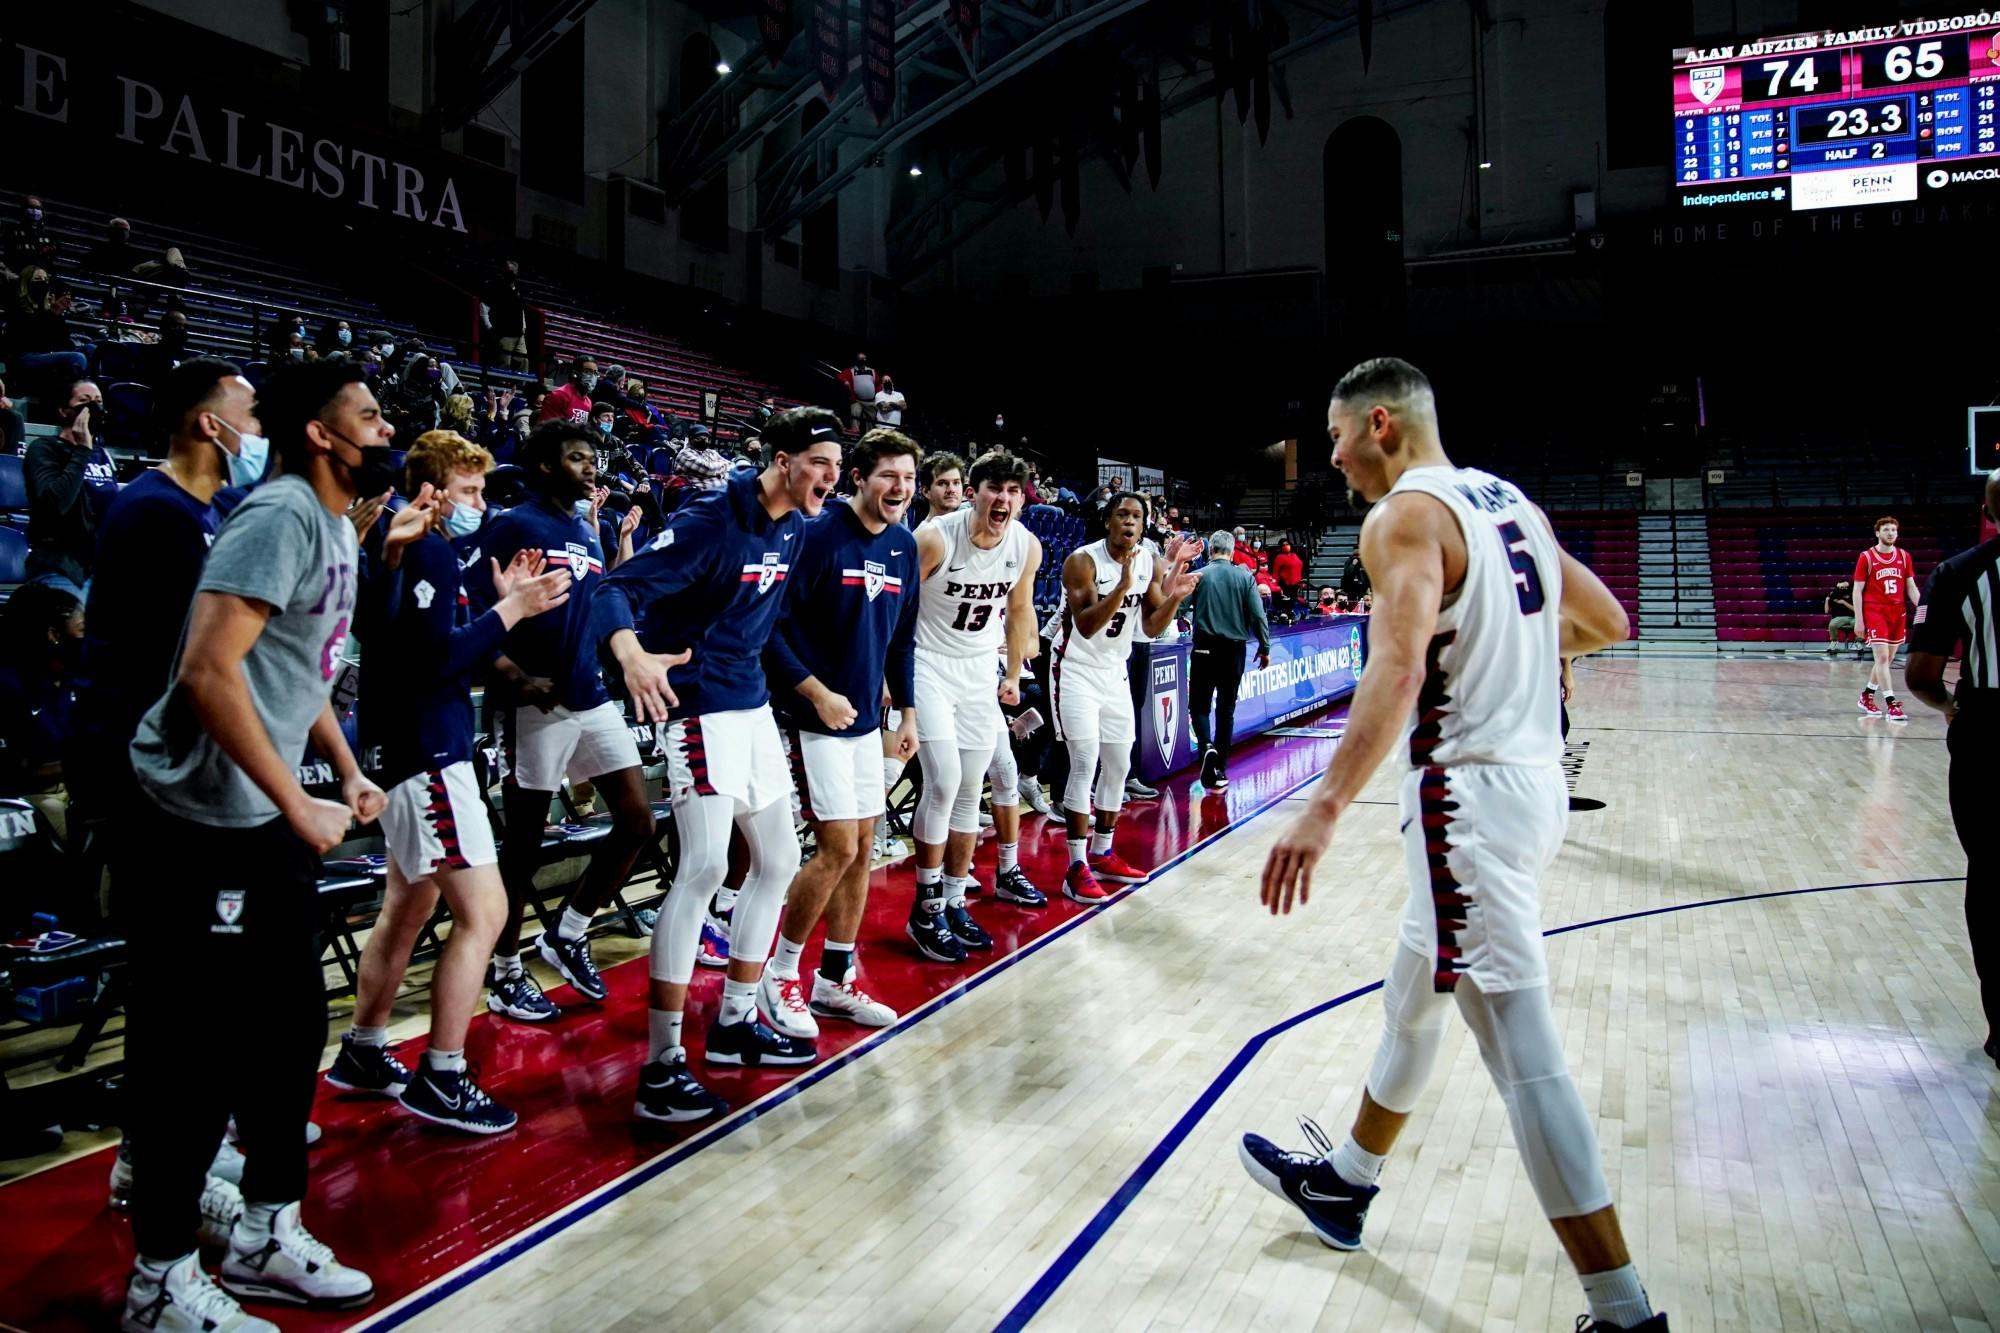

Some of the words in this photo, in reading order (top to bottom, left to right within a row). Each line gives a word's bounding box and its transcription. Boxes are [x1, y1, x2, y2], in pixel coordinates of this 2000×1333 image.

[1684, 46, 1734, 64] ALAN
[1738, 35, 1819, 57] AUFZIEN
[1823, 25, 1897, 47] FAMILY
[1885, 41, 1944, 82] 65
[1693, 68, 1721, 80] PENN
[1763, 57, 1819, 96] 74
[1977, 85, 1995, 97] 13
[1920, 95, 1929, 106] 3
[1935, 92, 1961, 103] TOL
[1749, 113, 1772, 124] TOL
[1776, 111, 1784, 122] 1
[1827, 104, 1902, 138] 23.3
[1917, 111, 1933, 123] 10
[1936, 109, 1960, 120] FLS
[1978, 113, 1994, 125] 21
[1685, 119, 1694, 130] 0
[1936, 126, 1963, 136] BON
[1713, 129, 1720, 139] 1
[1752, 129, 1773, 140] FLS
[1776, 127, 1786, 138] 7
[1978, 127, 1995, 139] 25
[1684, 144, 1697, 155] 11
[1713, 142, 1720, 153] 1
[1726, 140, 1741, 151] 13
[1748, 145, 1773, 156] BON
[1825, 147, 1858, 161] HALF
[1871, 142, 1885, 159] 2
[1937, 142, 1962, 153] POS
[1978, 141, 1995, 153] 30
[115, 75, 469, 234] PALESTRA
[1683, 157, 1698, 169] 22
[1750, 161, 1773, 171] POS
[1683, 170, 1699, 181] 40
[1853, 175, 1893, 188] PENN
[1683, 190, 1769, 206] Independence
[1653, 223, 1728, 246] HOME
[1752, 218, 1784, 238] OF
[1810, 212, 1865, 233] THE
[1496, 519, 1545, 616] 5
[1876, 567, 1903, 580] CORNELL
[944, 580, 1012, 600] PENN
[1884, 579, 1898, 594] 15
[951, 601, 993, 632] 13
[1106, 611, 1127, 638] 3
[1154, 663, 1176, 686] PENN
[1235, 661, 1288, 703] AMFITTERS
[1288, 655, 1315, 685] LOCAL
[1315, 648, 1338, 677] UNION
